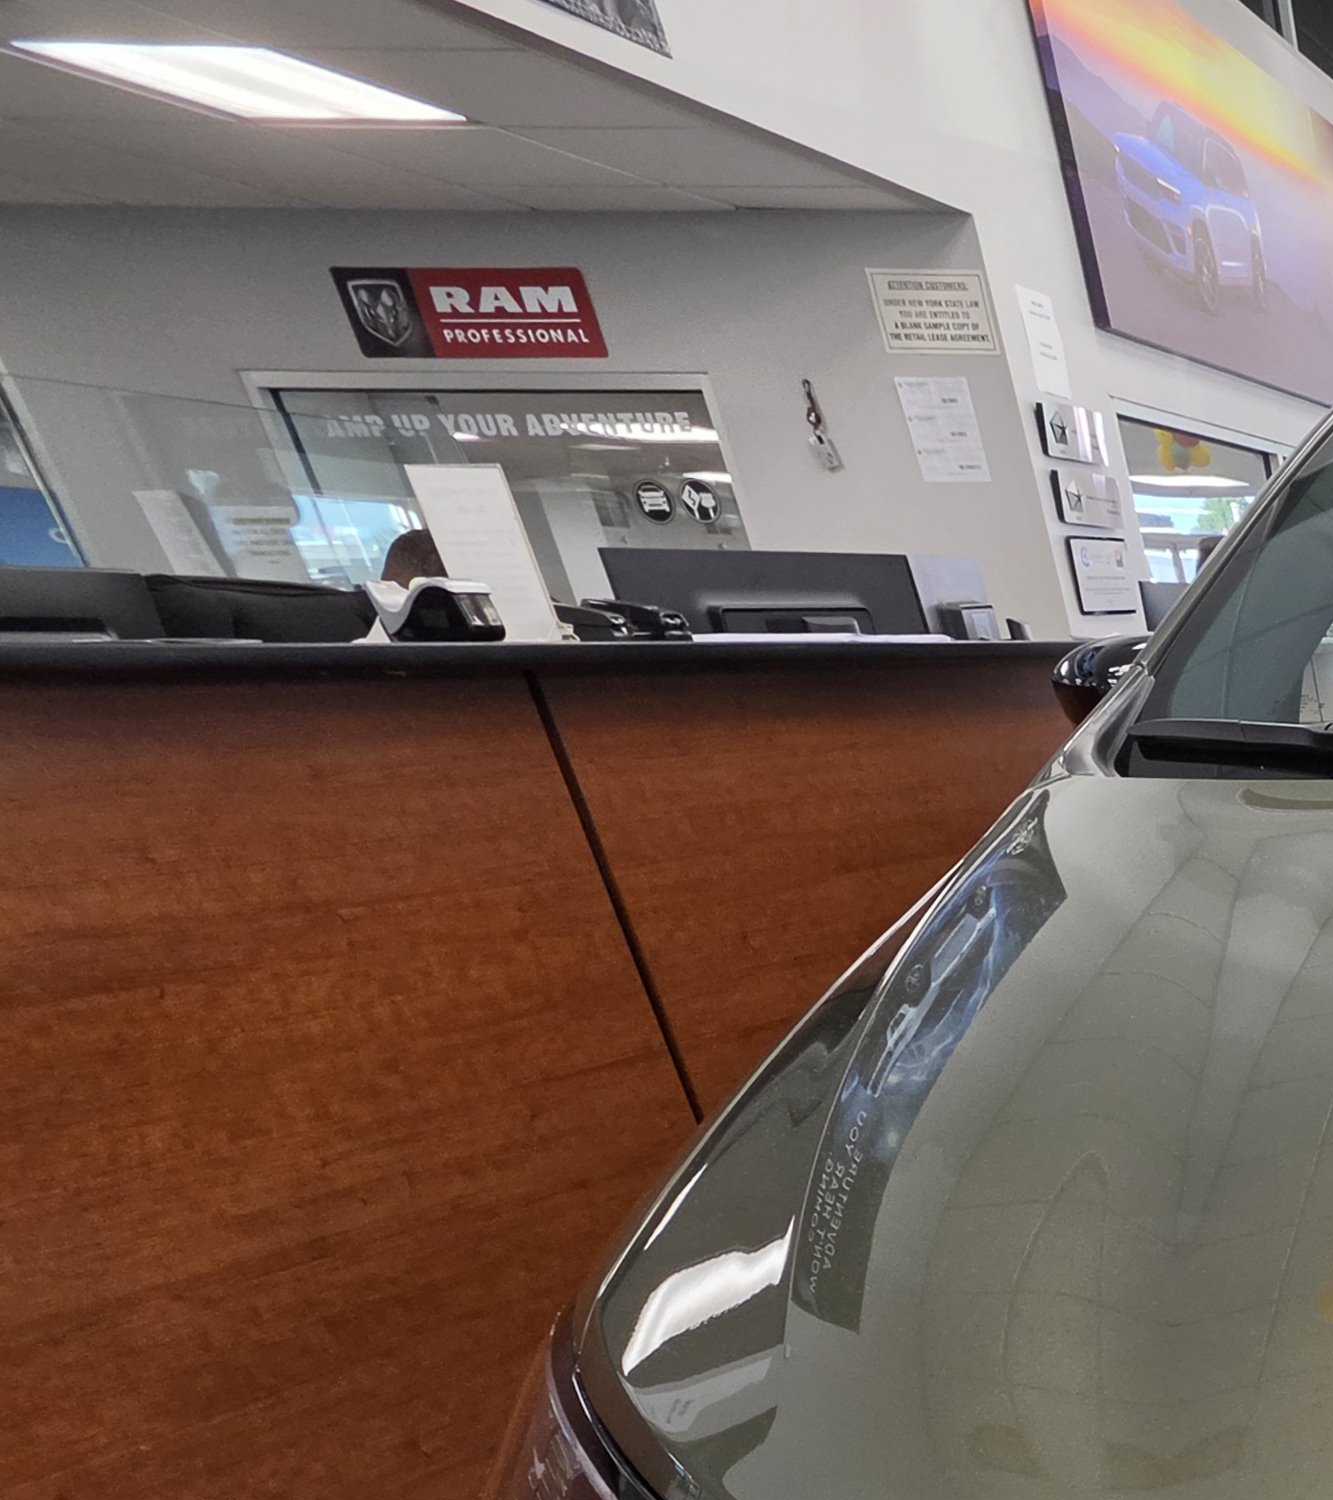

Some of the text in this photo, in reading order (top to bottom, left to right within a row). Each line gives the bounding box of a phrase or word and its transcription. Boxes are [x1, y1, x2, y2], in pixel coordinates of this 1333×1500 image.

[429, 286, 579, 313] RAM
[883, 299, 979, 308] UNDER NEW YORK STATE LAW
[899, 310, 971, 319] YOU ARE ENTITLED TO
[901, 322, 922, 330] BLANK
[924, 322, 951, 331] SAMPLE
[952, 322, 970, 331] COPY
[443, 328, 589, 344] PROFESSIONAL
[890, 332, 903, 341] THE
[905, 333, 927, 342] RETAIL
[928, 333, 949, 342] LEASE
[439, 413, 519, 438] YOUR
[526, 411, 692, 438] ADVENTURE
